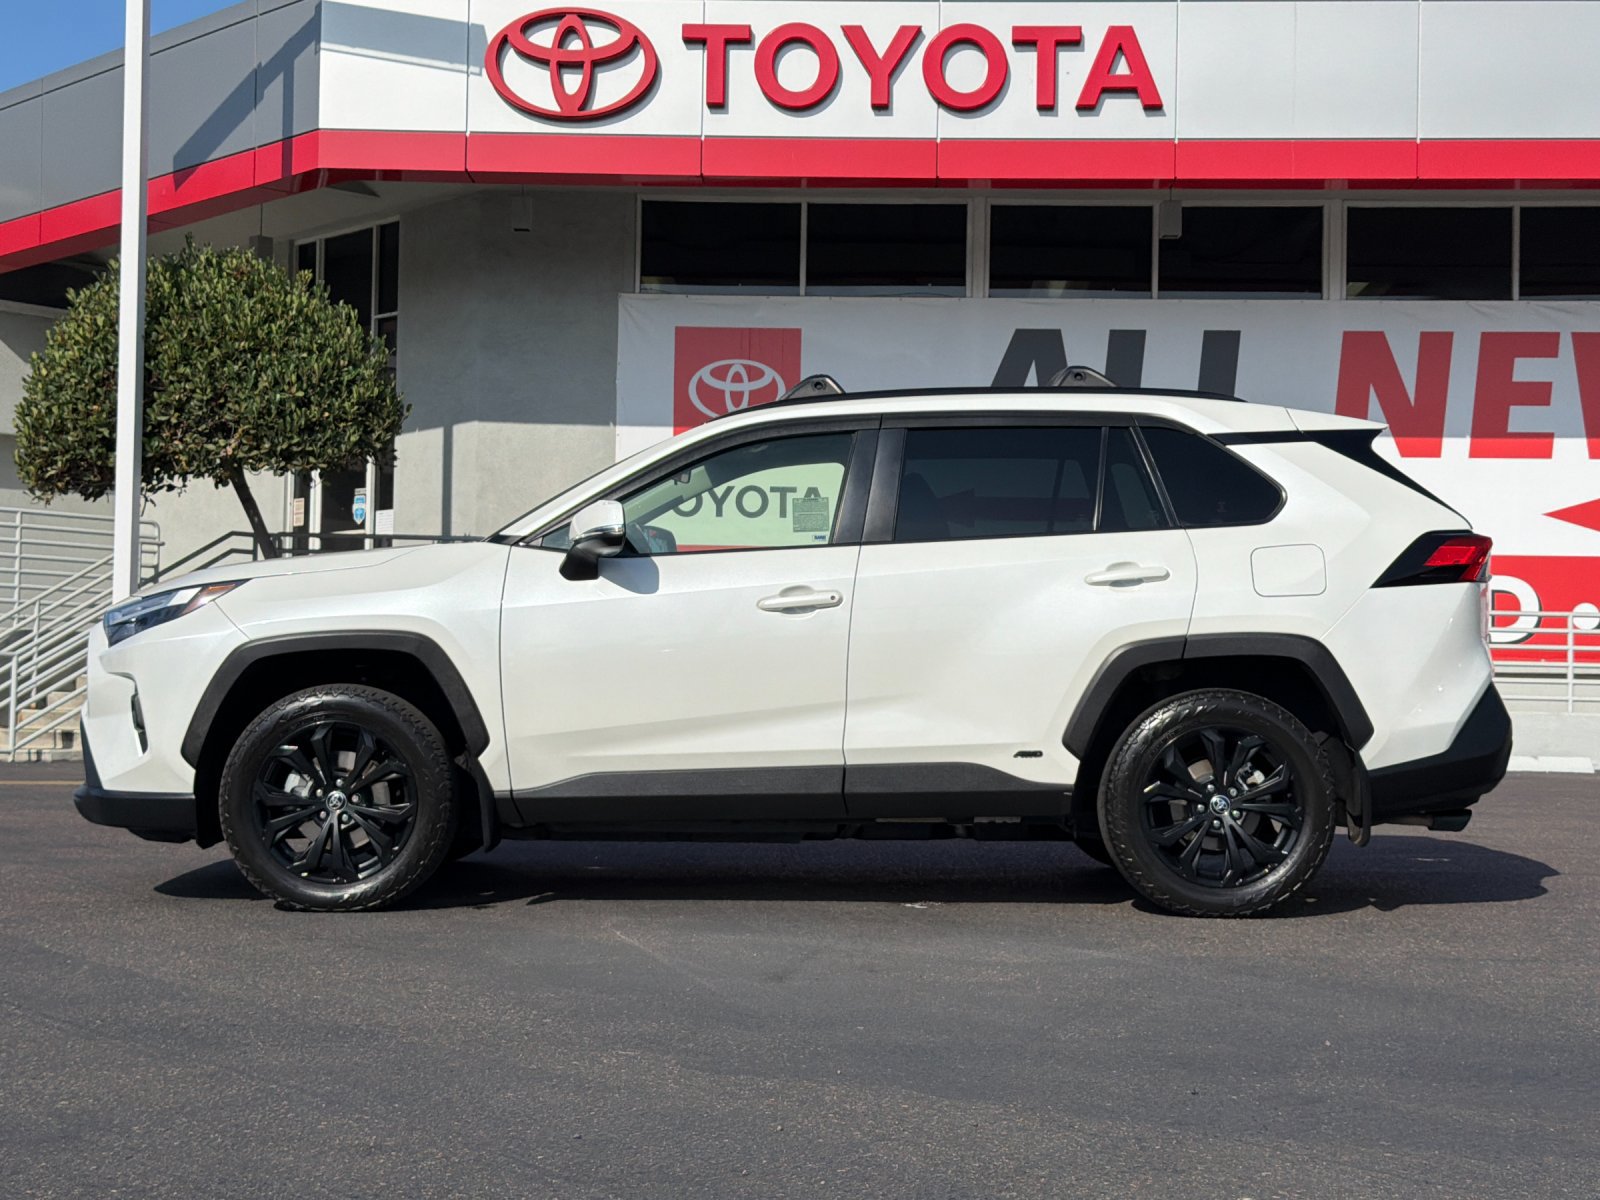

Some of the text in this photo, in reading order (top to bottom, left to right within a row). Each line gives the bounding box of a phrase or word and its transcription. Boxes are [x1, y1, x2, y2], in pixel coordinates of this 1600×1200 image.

[681, 22, 1163, 110] TOYOTA
[1335, 331, 1600, 459] NE
[672, 485, 824, 518] OYOT
